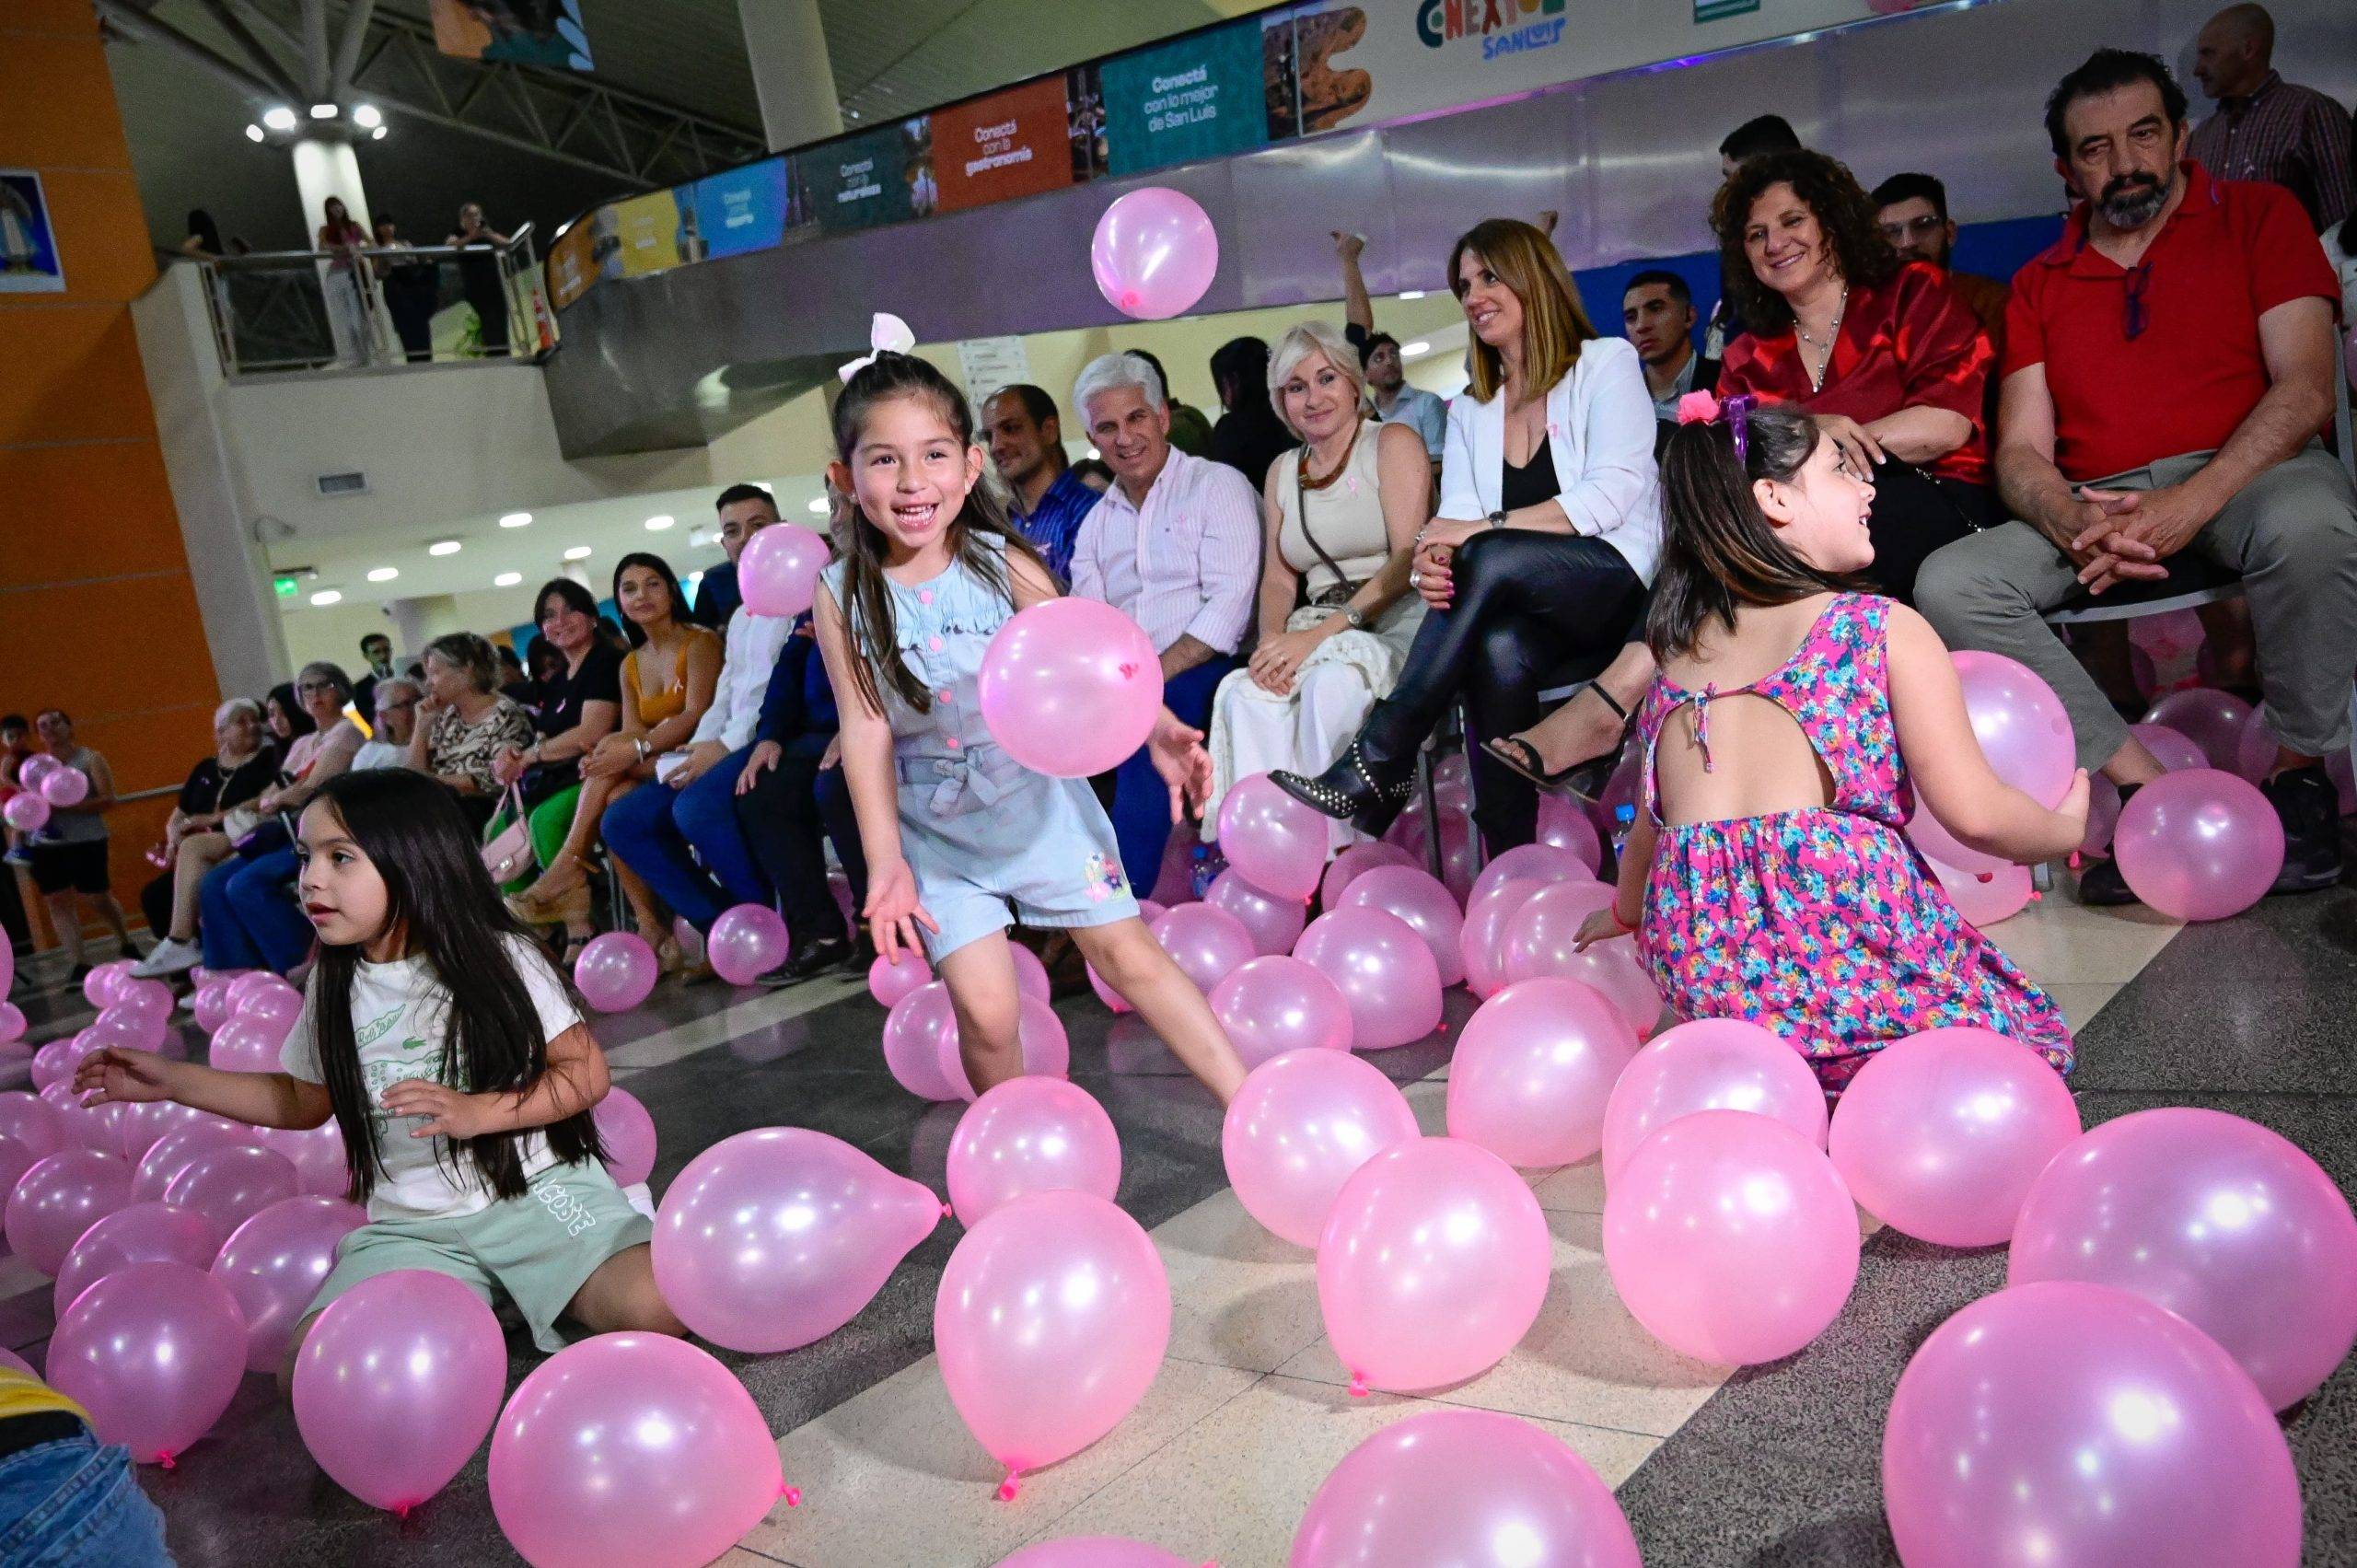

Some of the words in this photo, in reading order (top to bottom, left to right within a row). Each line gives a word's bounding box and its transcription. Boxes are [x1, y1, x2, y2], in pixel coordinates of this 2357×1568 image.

[1152, 64, 1207, 93] Conectá
[1148, 117, 1165, 132] de
[1165, 110, 1190, 128] San
